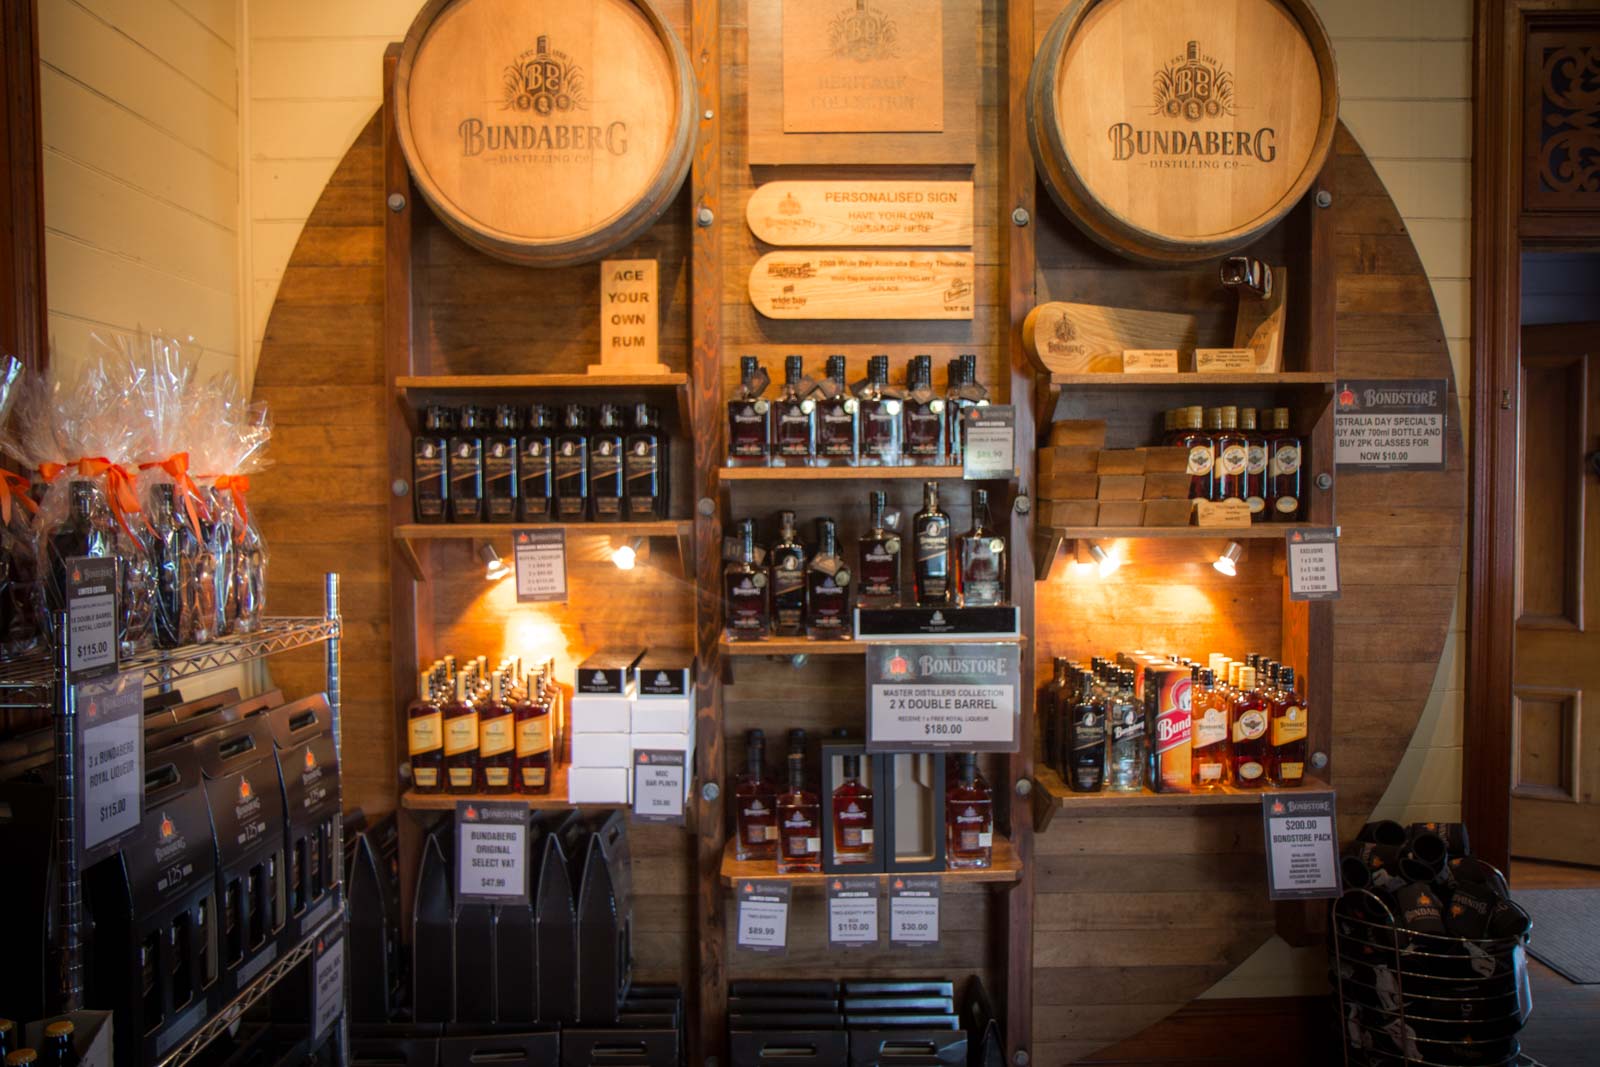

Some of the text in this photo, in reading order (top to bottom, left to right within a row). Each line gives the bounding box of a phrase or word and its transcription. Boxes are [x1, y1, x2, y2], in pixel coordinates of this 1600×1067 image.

[458, 118, 628, 157] BUNDABERG
[1108, 122, 1276, 163] BUNDABERG
[1149, 160, 1220, 169] DISTILLING
[824, 191, 958, 204] PERSONALISED SIGN
[848, 211, 935, 220] HAVE YOUR OWN
[851, 224, 932, 233] MESSAGE HERE
[614, 270, 644, 281] AGE
[608, 292, 649, 303] YOUR
[611, 314, 646, 326] OWN
[612, 336, 646, 347] RUM
[1363, 389, 1437, 407] BONDSTORE
[1375, 417, 1392, 426] DAY
[1350, 429, 1367, 437] ANY
[1368, 429, 1390, 437] 700ml
[1391, 429, 1424, 437] BOTTLE
[1424, 428, 1441, 436] AND
[1339, 439, 1429, 447] BUY 2PK GLASSES FOR
[1360, 451, 1408, 461] NOW $10.00
[77, 641, 108, 658] $115.00
[919, 655, 1007, 676] BONDSTORE
[889, 699, 997, 709] 2 X DOUBLE BARREL
[924, 724, 962, 734] $180.00
[88, 756, 93, 768] 3
[99, 741, 135, 764] BUNDABERG
[89, 759, 135, 789] ROYAL LIQUEUR
[100, 798, 127, 822] $115.00
[1285, 820, 1317, 830] $200.00
[471, 831, 517, 841] BUNDABERG
[1273, 833, 1331, 843] BONDSTORE PACK
[476, 845, 511, 854] ORIGINAL
[472, 858, 515, 867] SELECT VAT
[838, 923, 869, 931] $110.00
[901, 923, 928, 931] $30.00
